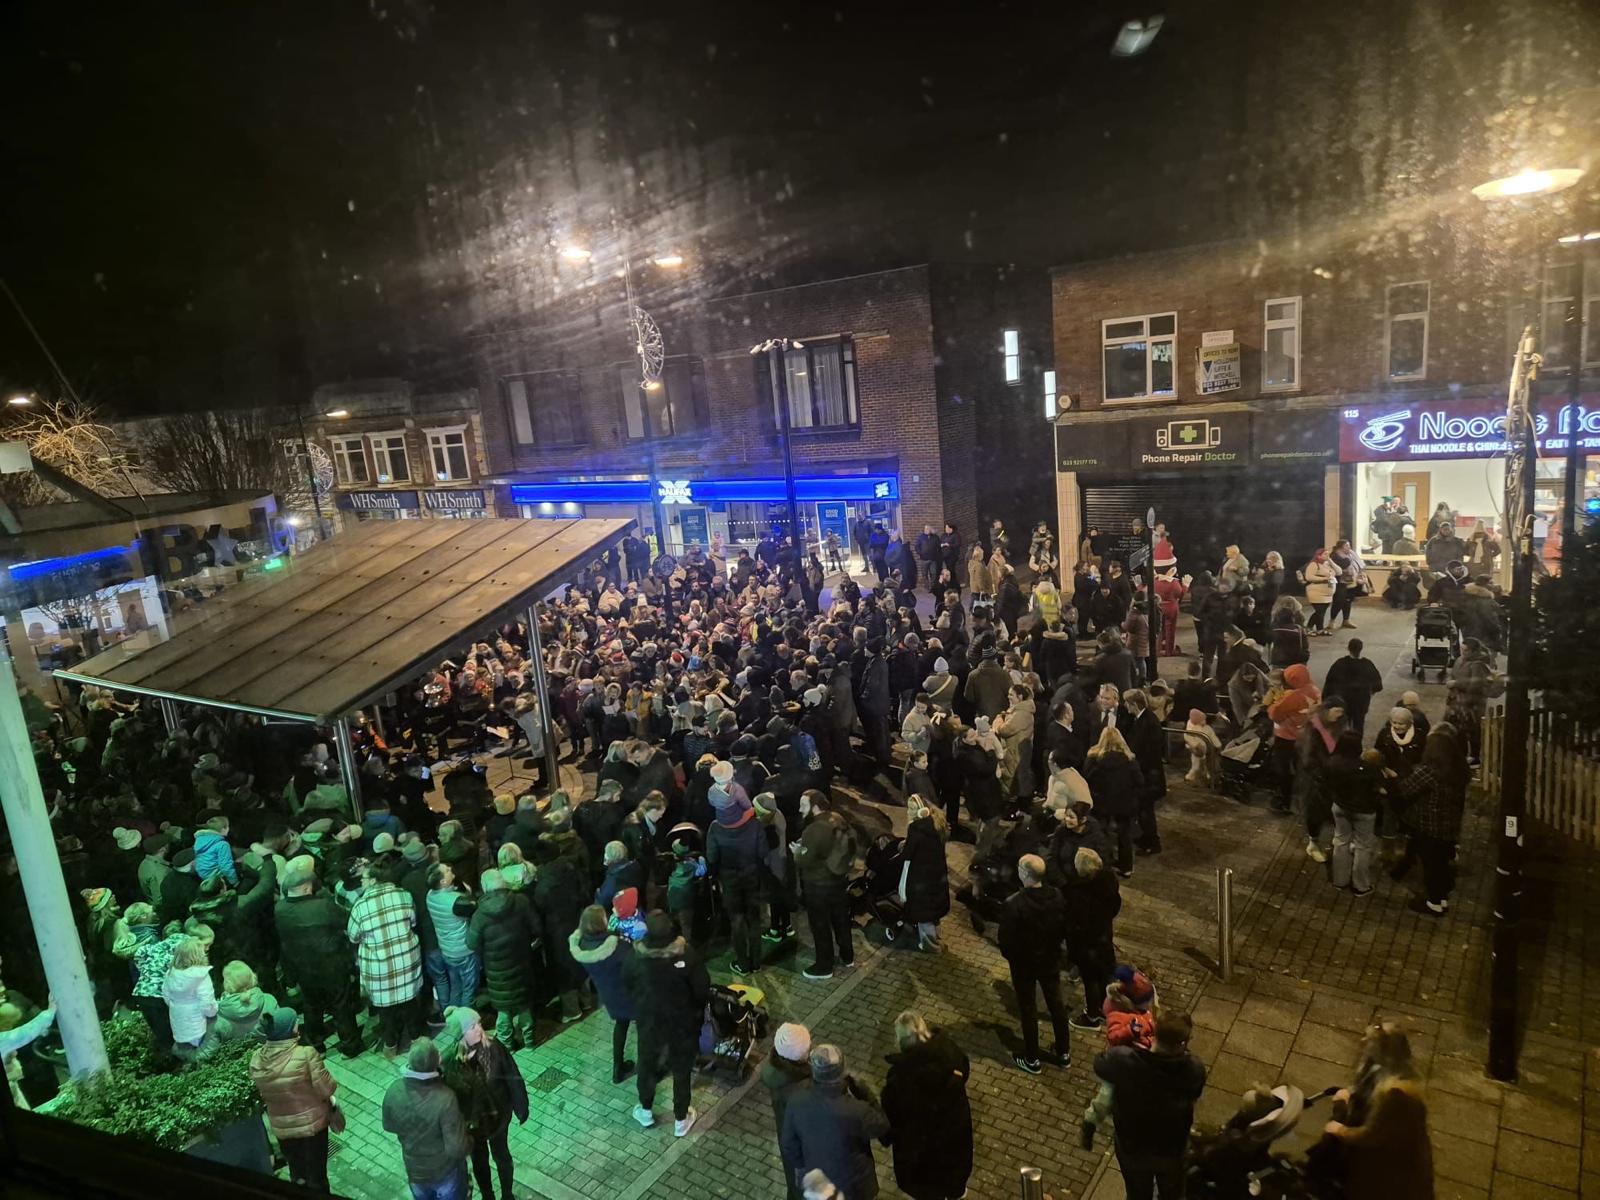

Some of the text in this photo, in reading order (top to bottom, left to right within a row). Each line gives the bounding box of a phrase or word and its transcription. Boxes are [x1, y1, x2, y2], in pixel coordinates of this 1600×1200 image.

[1344, 409, 1359, 418] 115
[1409, 444, 1430, 454] THAI
[1431, 442, 1466, 453] NOODLE
[1466, 441, 1474, 451] &
[1142, 452, 1236, 464] Phone Repair Doctor
[350, 493, 400, 509] WHSmith
[425, 491, 482, 509] WHSmith
